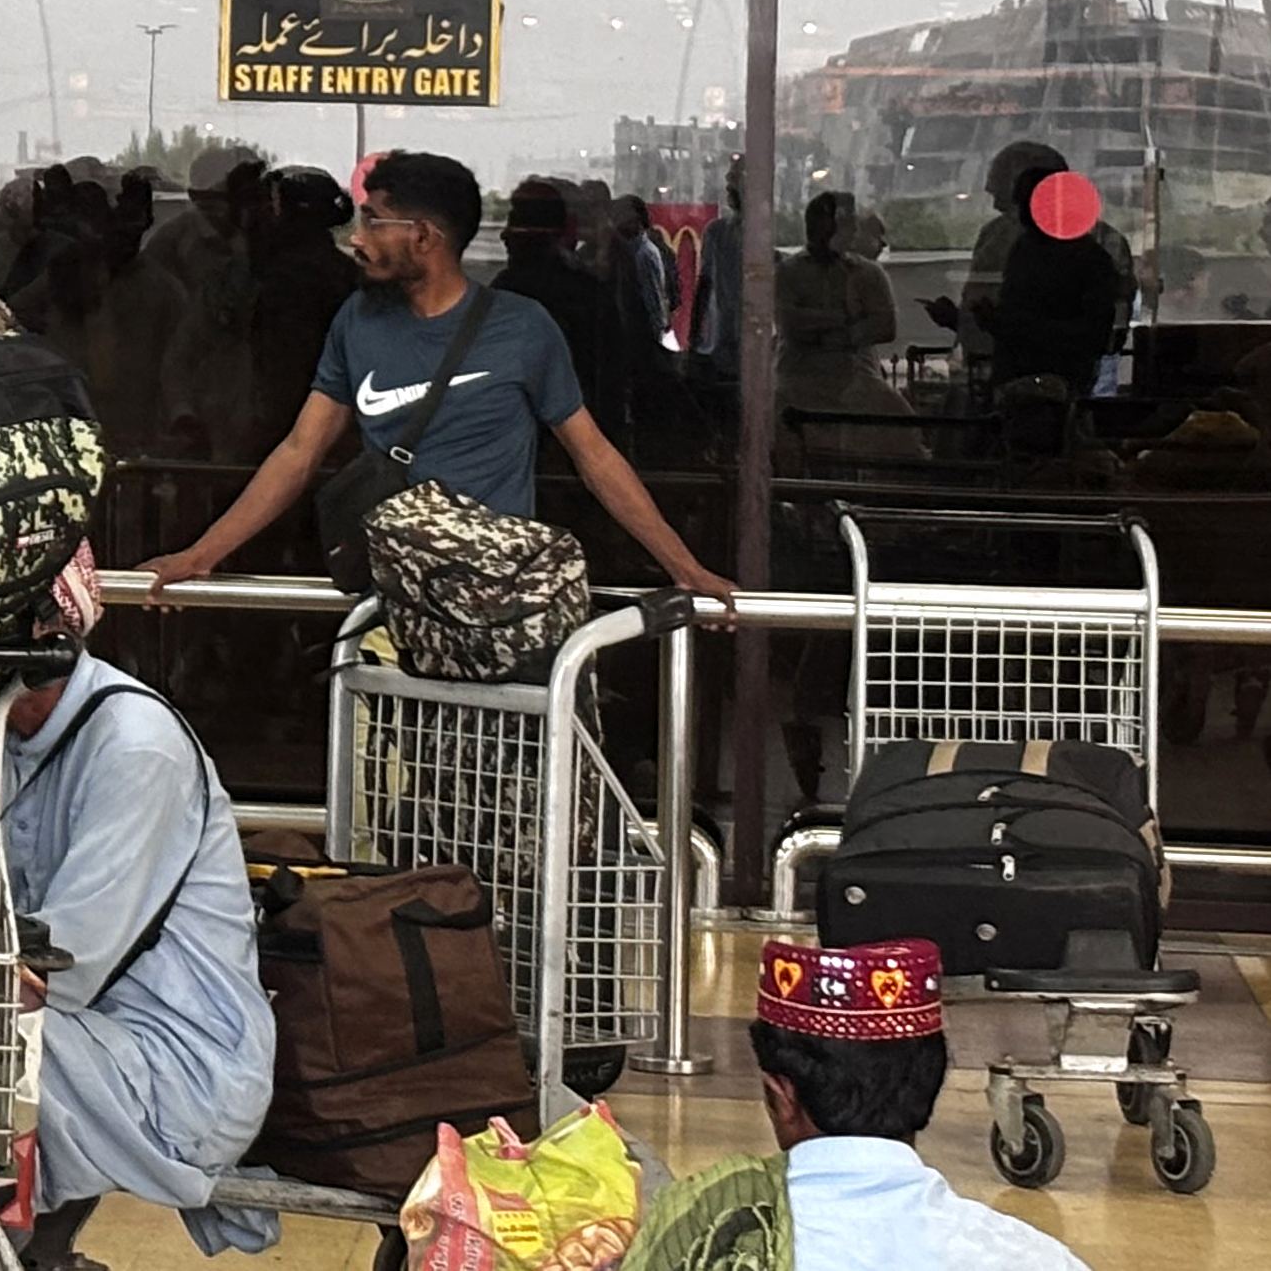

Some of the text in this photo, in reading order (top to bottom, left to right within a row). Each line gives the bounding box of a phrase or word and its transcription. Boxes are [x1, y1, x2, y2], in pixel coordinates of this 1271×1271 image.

[235, 11, 301, 57] عملہ
[399, 14, 483, 60] داخلہ
[234, 64, 482, 97] STAFF ENTRY GATE
